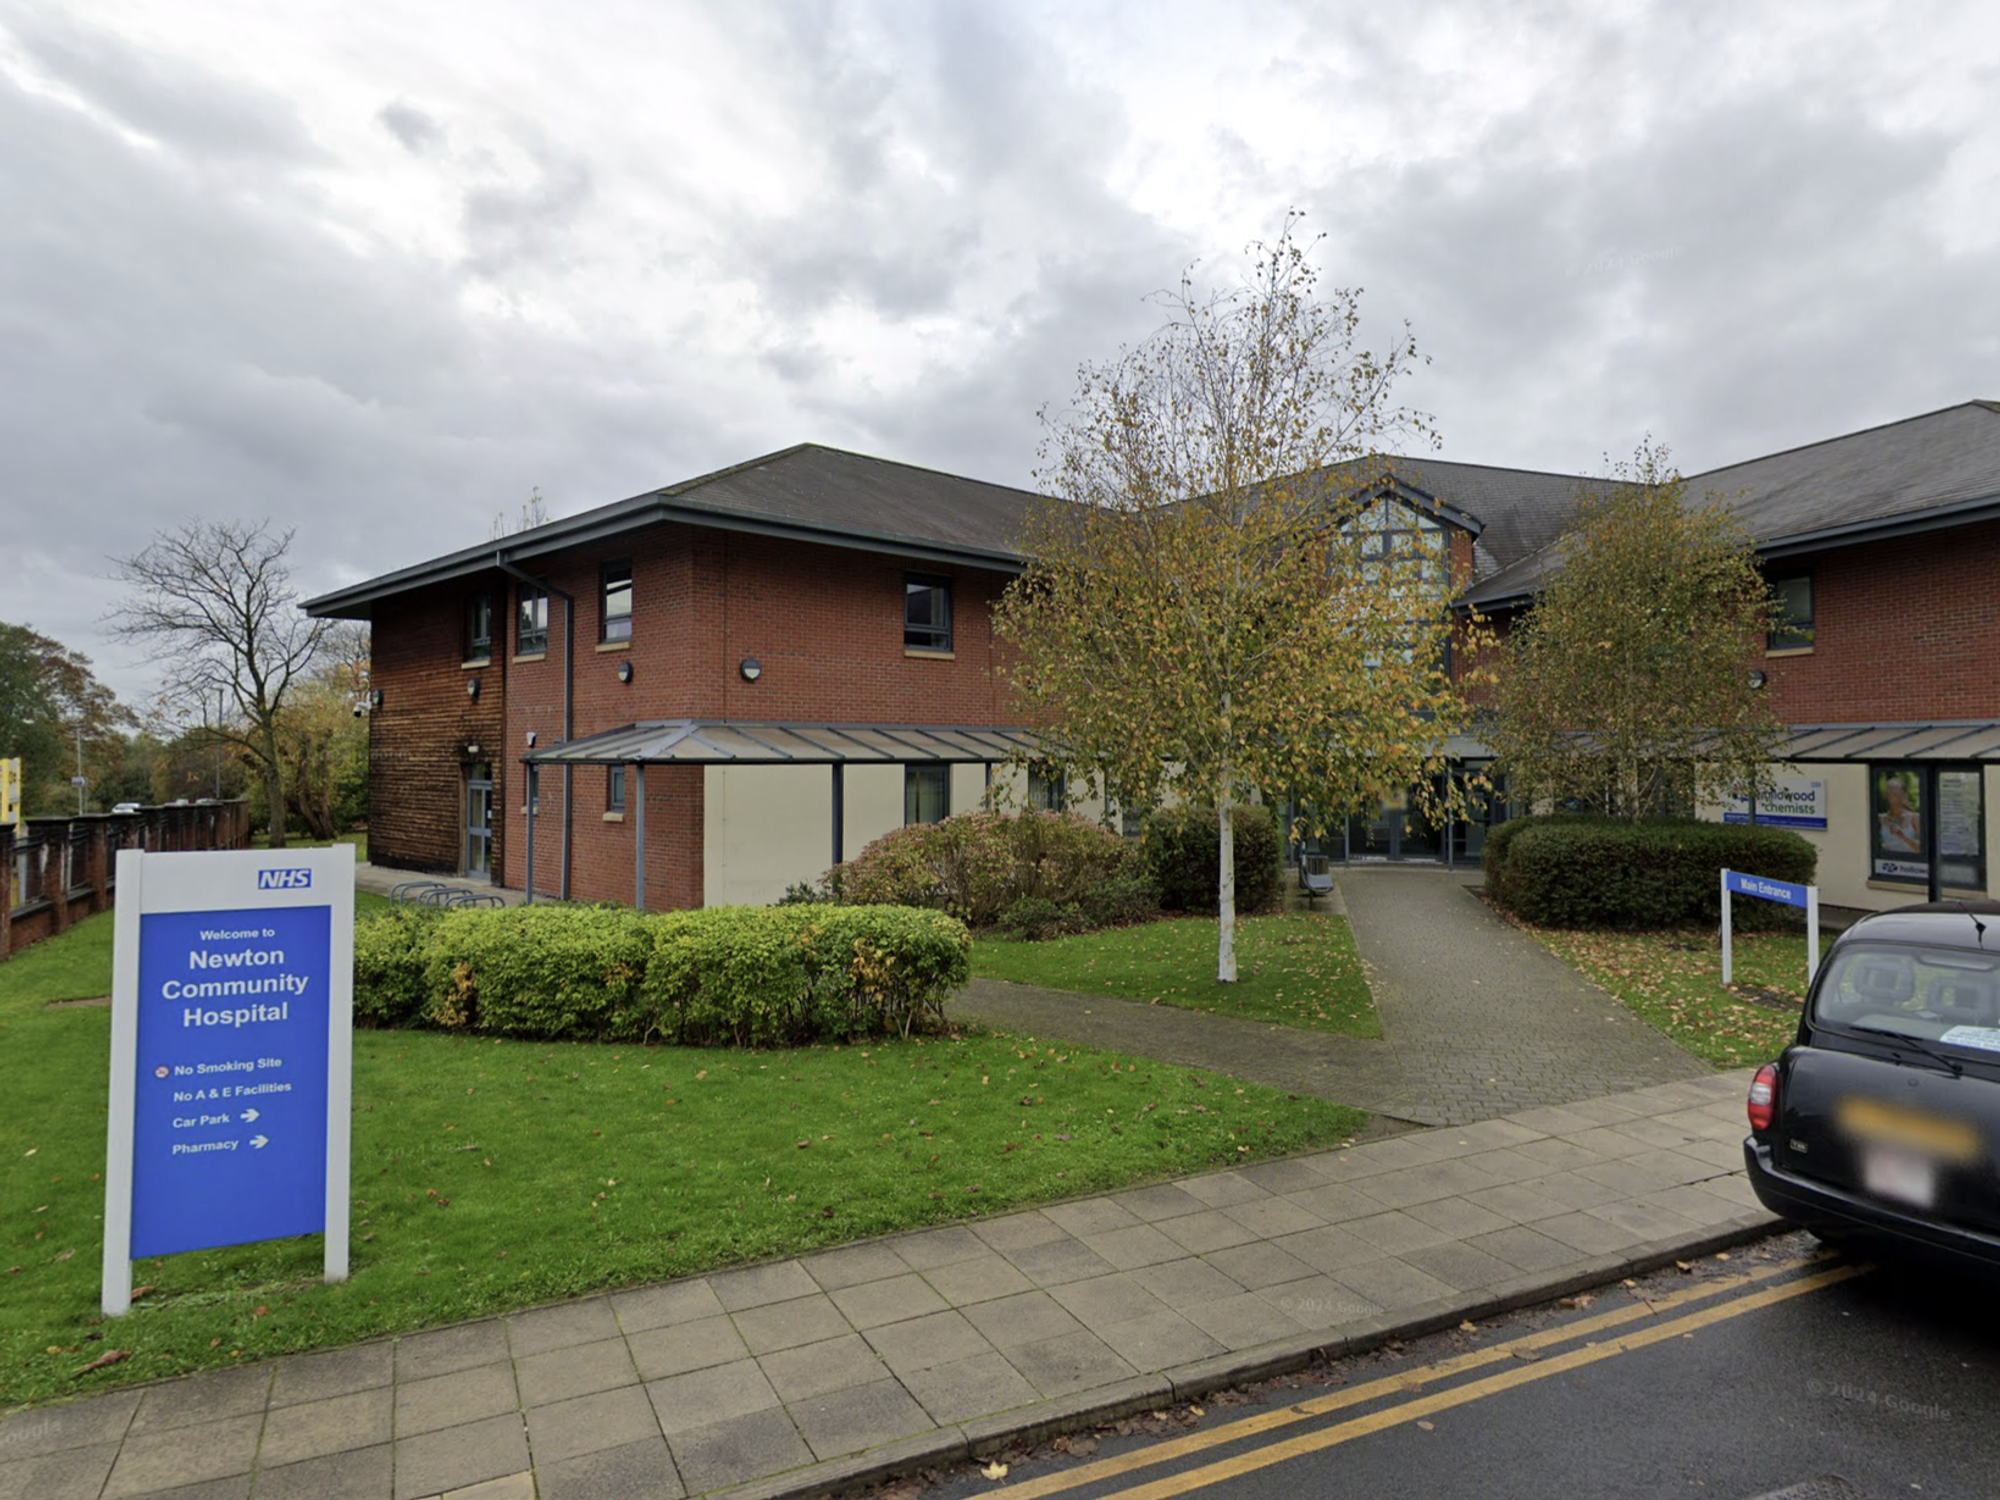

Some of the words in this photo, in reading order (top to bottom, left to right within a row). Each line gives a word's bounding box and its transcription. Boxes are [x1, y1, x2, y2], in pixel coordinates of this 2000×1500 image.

[1764, 802, 1816, 815] chemists
[259, 869, 310, 888] NHS
[1741, 878, 1758, 892] Main
[1758, 881, 1791, 900] Entrance
[200, 929, 259, 941] Welcome
[262, 927, 275, 937] to
[189, 948, 284, 970] Newton
[162, 973, 309, 1000] Community
[183, 1001, 288, 1028] Hospital
[174, 1065, 194, 1076] No
[197, 1060, 254, 1075] Smoking
[257, 1057, 282, 1069] Site
[173, 1091, 193, 1102] No
[195, 1089, 206, 1100] A
[208, 1088, 219, 1099] &
[222, 1087, 232, 1098] E
[235, 1082, 292, 1097] Facilities
[172, 1117, 197, 1129] Car
[200, 1113, 230, 1126] Park
[172, 1139, 239, 1155] Pharmacy
